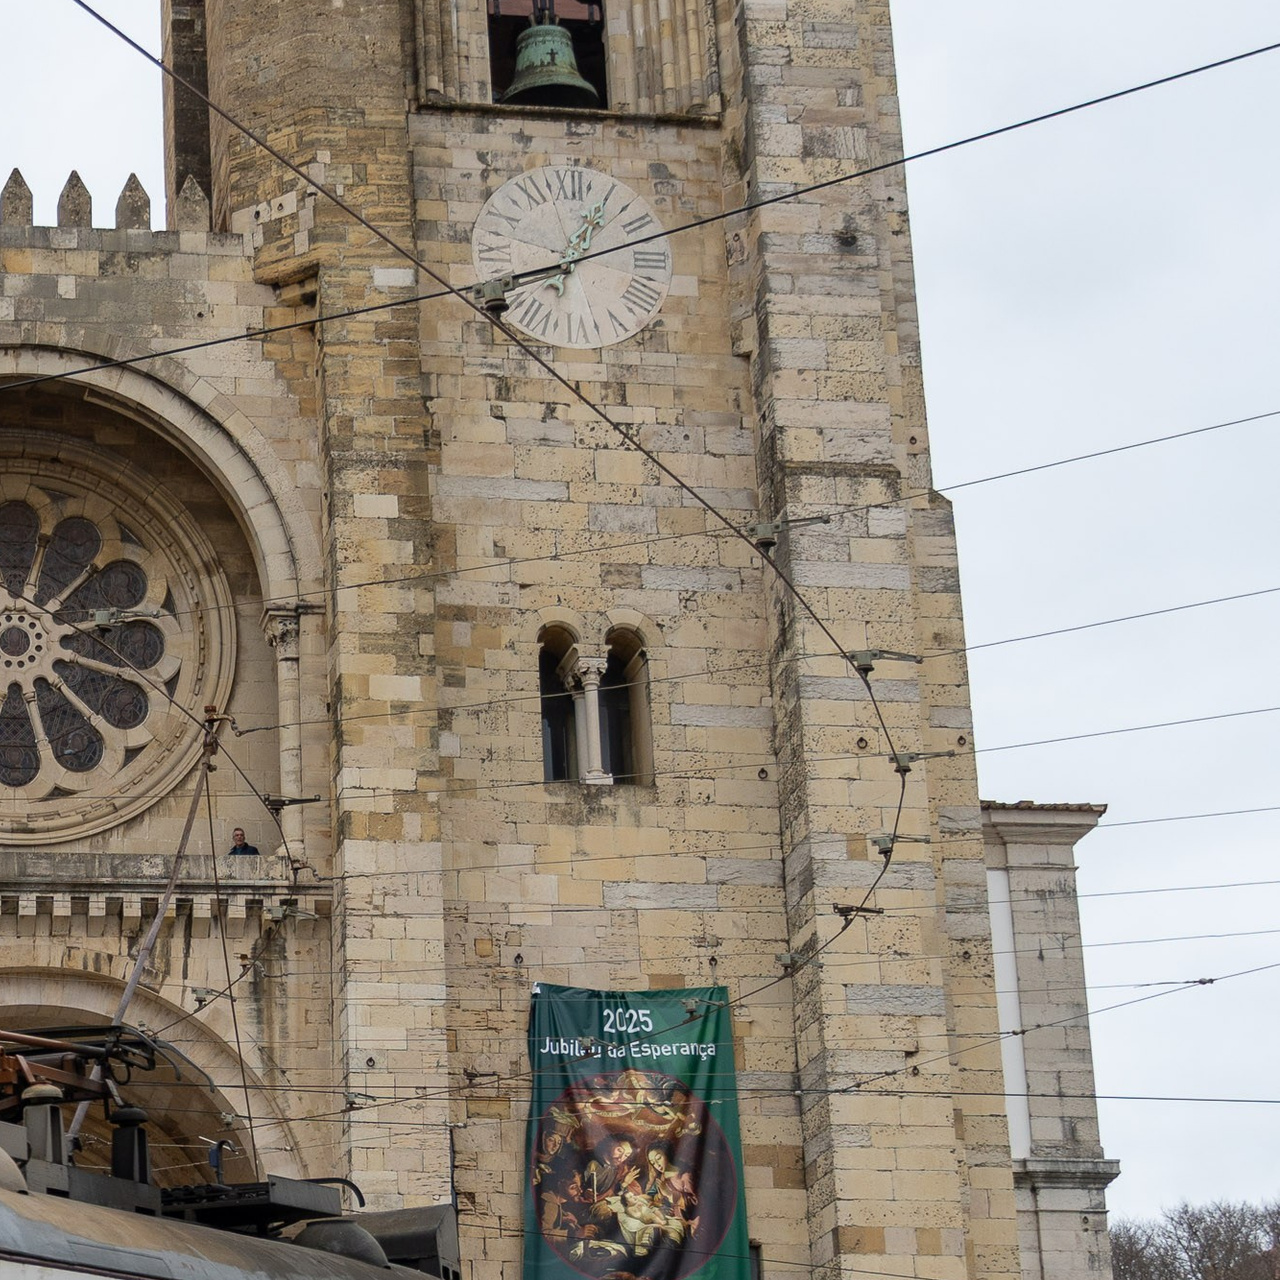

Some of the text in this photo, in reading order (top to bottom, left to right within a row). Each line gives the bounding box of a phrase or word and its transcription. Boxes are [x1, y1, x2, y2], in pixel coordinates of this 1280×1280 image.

[513, 175, 548, 211] XI
[553, 170, 584, 202] XII
[486, 203, 521, 230] X
[620, 212, 655, 236] II
[478, 241, 511, 263] IX
[632, 248, 666, 271] III
[620, 276, 662, 315] IIII
[517, 296, 553, 337] VII
[564, 312, 592, 344] VI
[606, 308, 630, 338] V
[603, 1008, 653, 1033] 2025
[631, 1041, 716, 1061] Esperança
